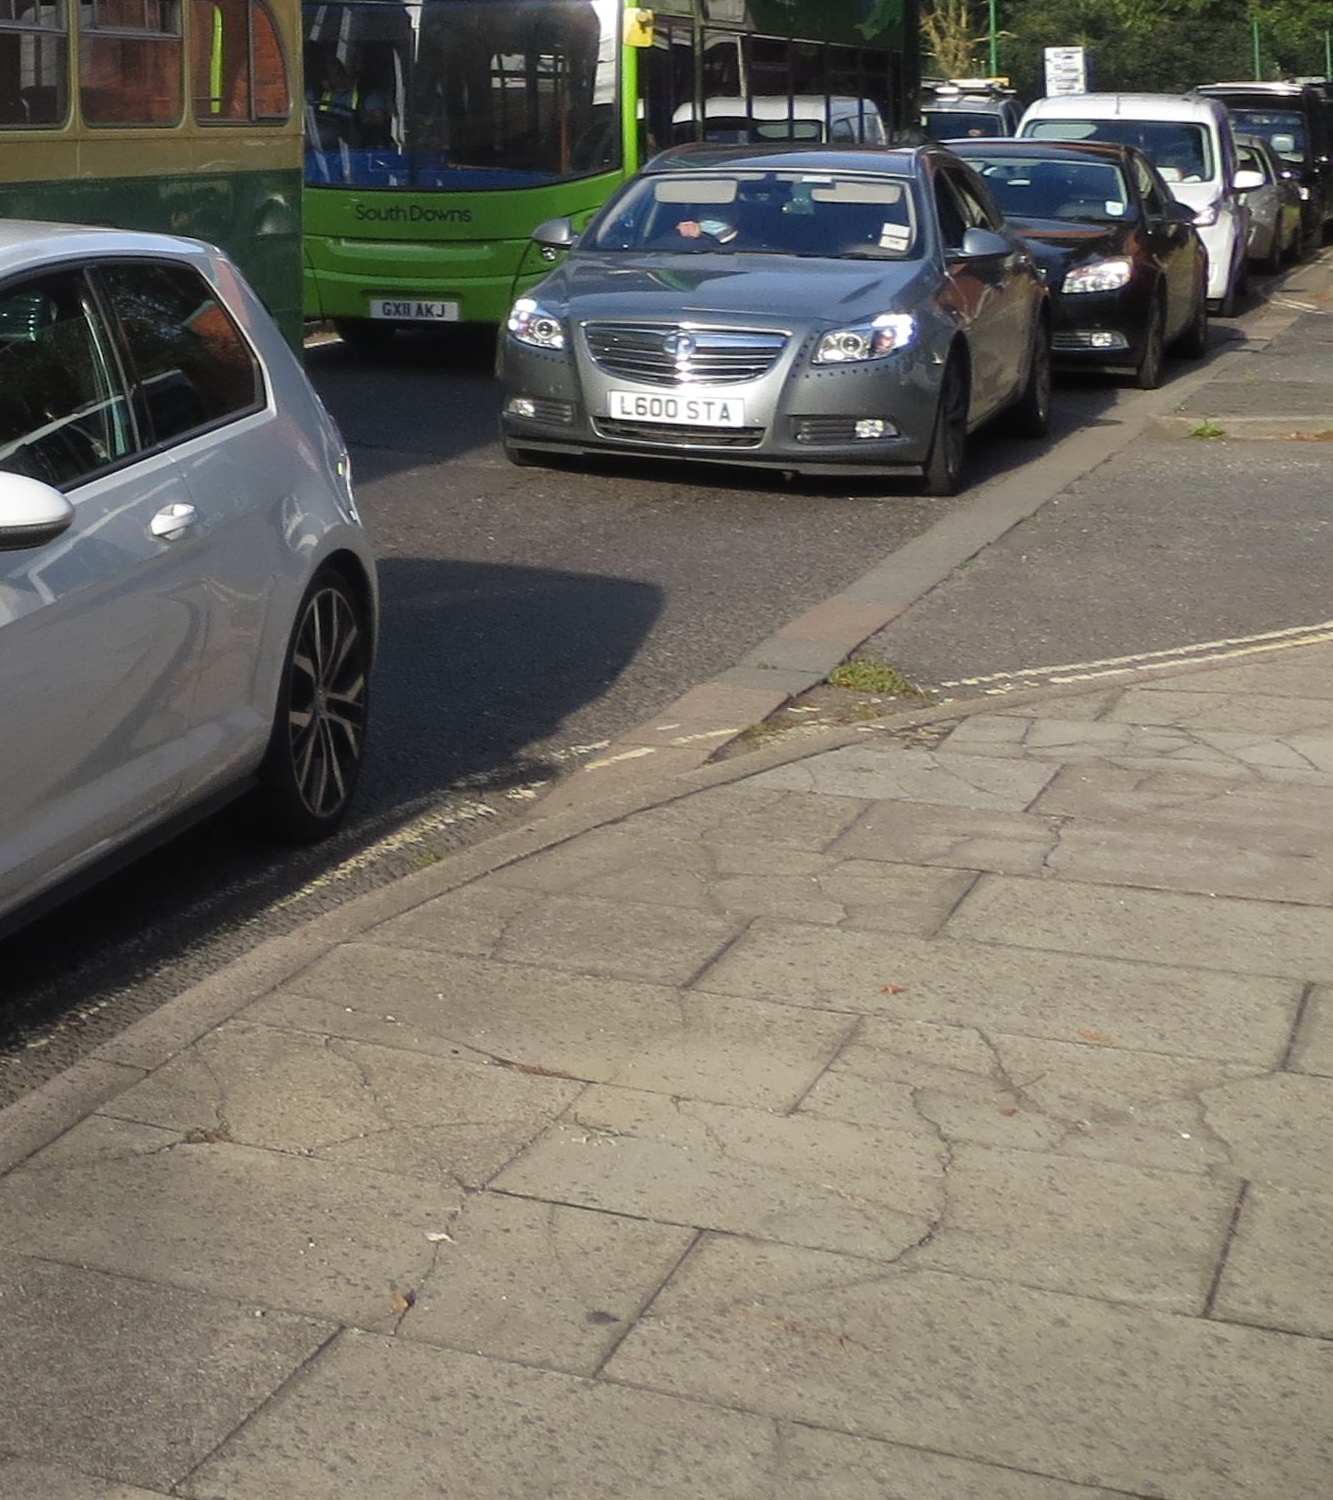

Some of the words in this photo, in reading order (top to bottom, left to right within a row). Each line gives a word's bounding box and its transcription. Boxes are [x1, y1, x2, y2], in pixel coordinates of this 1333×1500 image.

[382, 302, 411, 316] GX11
[415, 303, 446, 318] AKJ
[620, 395, 678, 418] L600
[686, 400, 731, 422] STA
